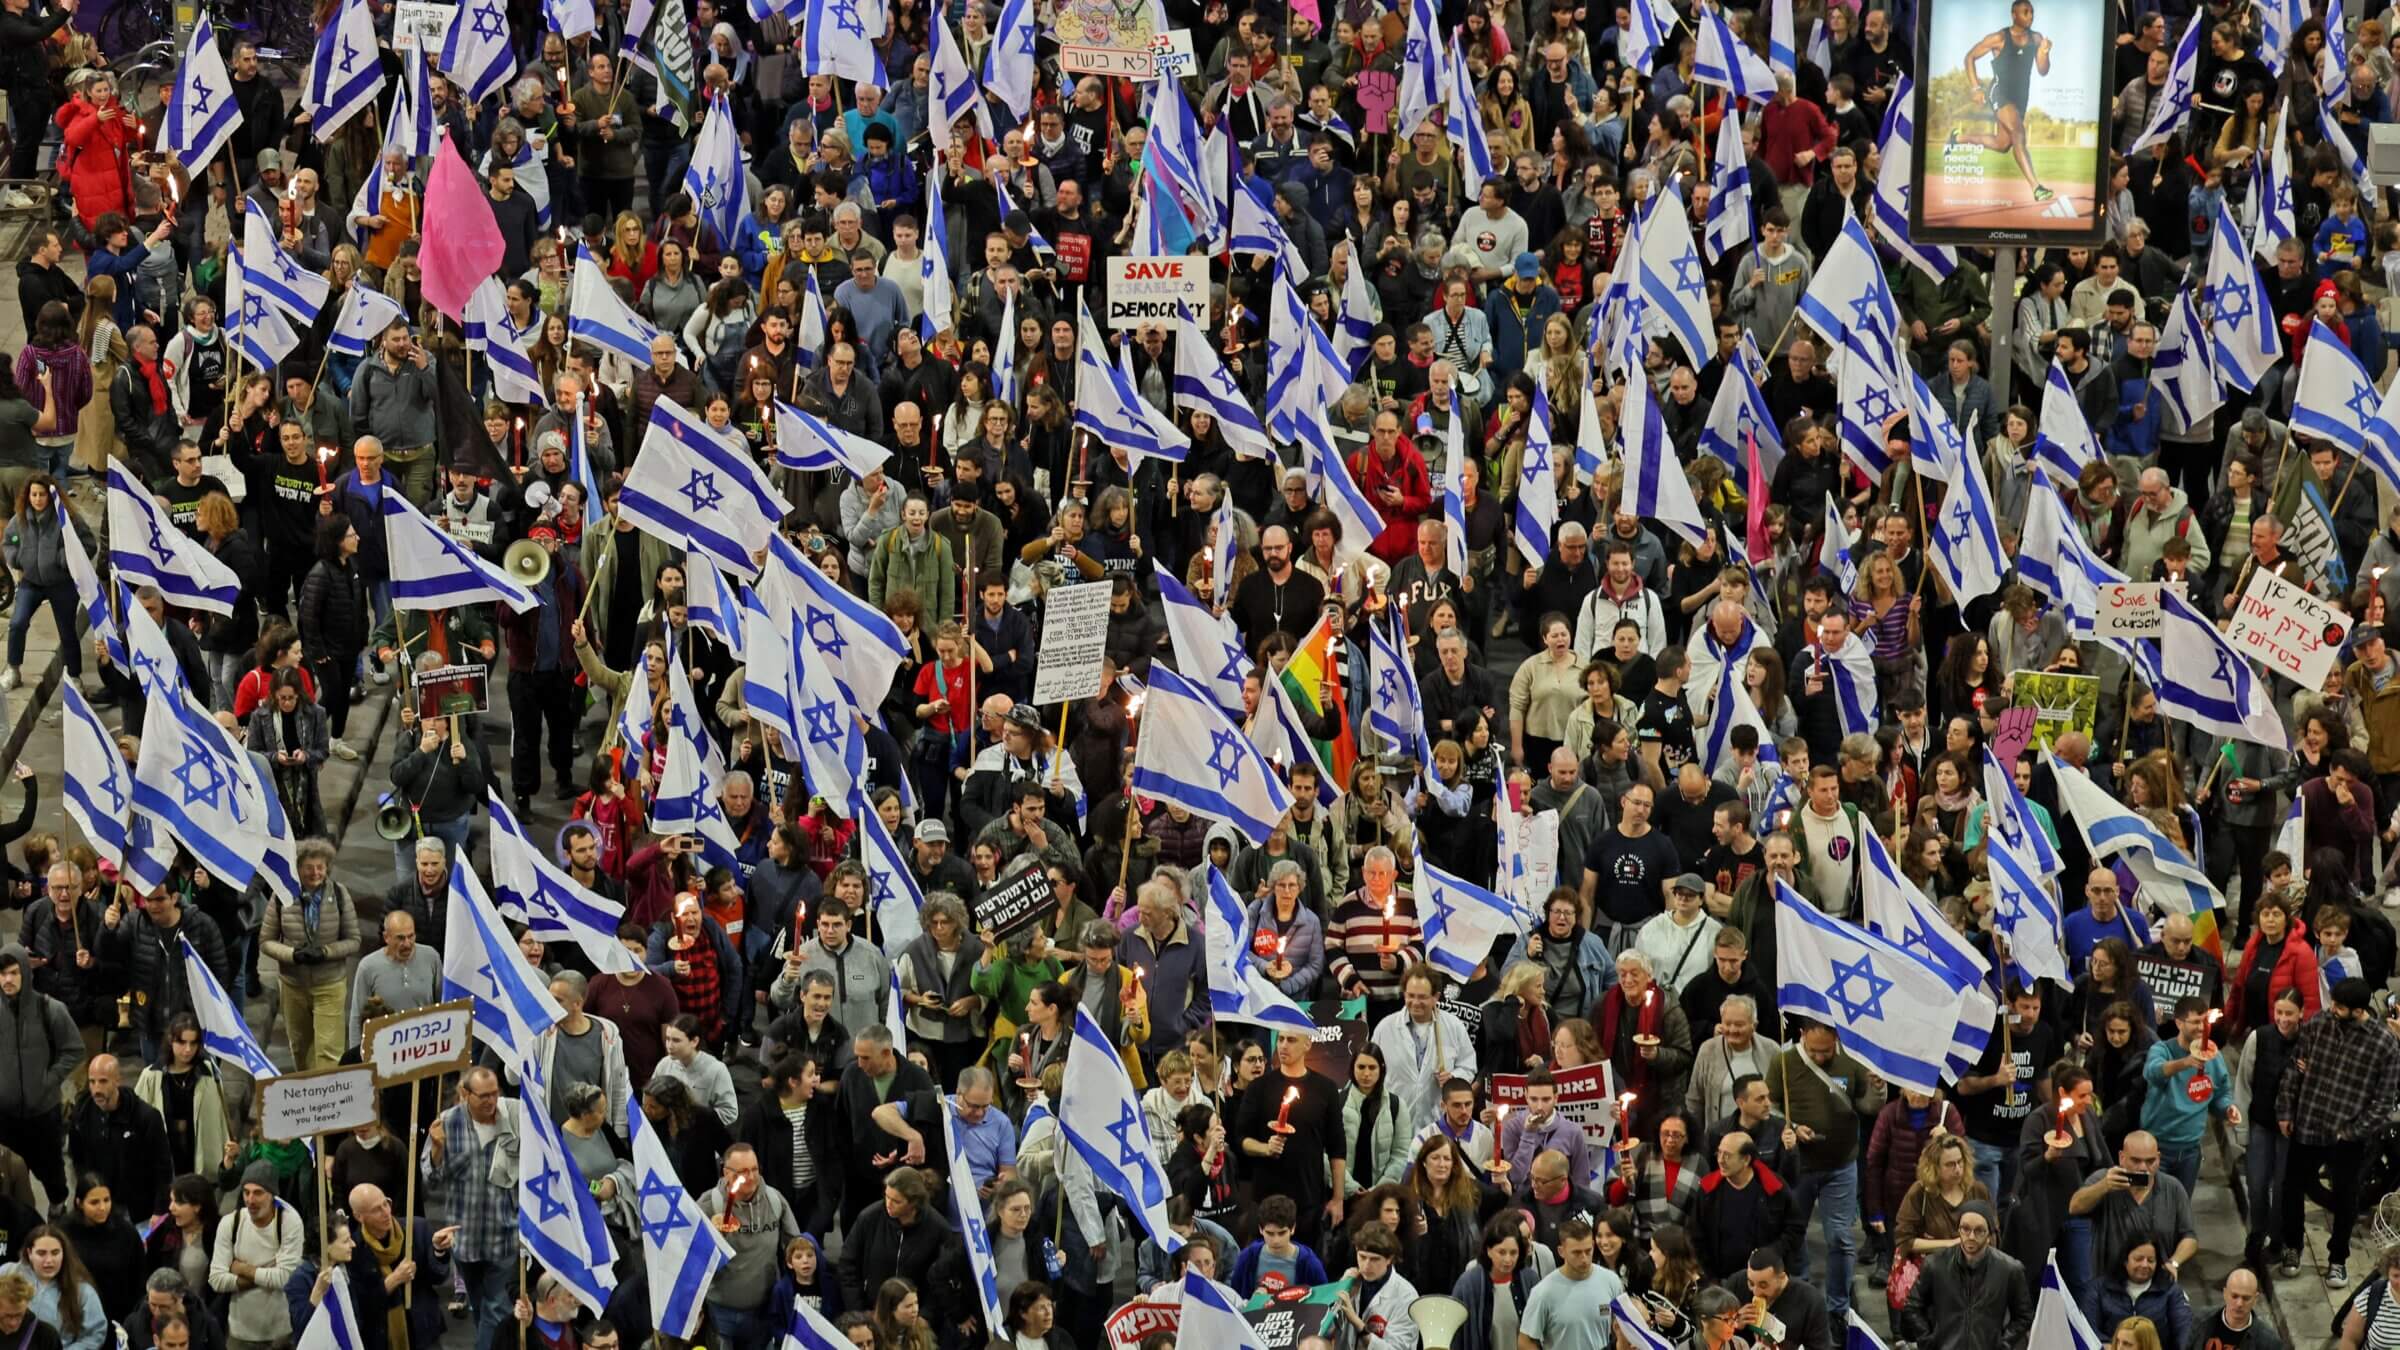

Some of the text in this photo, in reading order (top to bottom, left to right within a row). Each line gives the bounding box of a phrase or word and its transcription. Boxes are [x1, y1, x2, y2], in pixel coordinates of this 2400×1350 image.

[1944, 165, 1984, 176] nothing
[1988, 231, 2028, 240] JCDecaux
[1124, 263, 1183, 280] SAVE
[2110, 586, 2147, 608] Save
[2130, 609, 2155, 617] from
[974, 869, 1044, 919] אין דמוקרטיה
[994, 883, 1050, 926] עם כיבוש
[2137, 959, 2204, 985] הכיבוש
[389, 1017, 451, 1047] נבצרות
[392, 1039, 451, 1065] עכשיו!
[284, 1079, 353, 1099] Netanyahu:
[281, 1095, 354, 1117] What legacy will
[295, 1111, 341, 1125] you leave?
